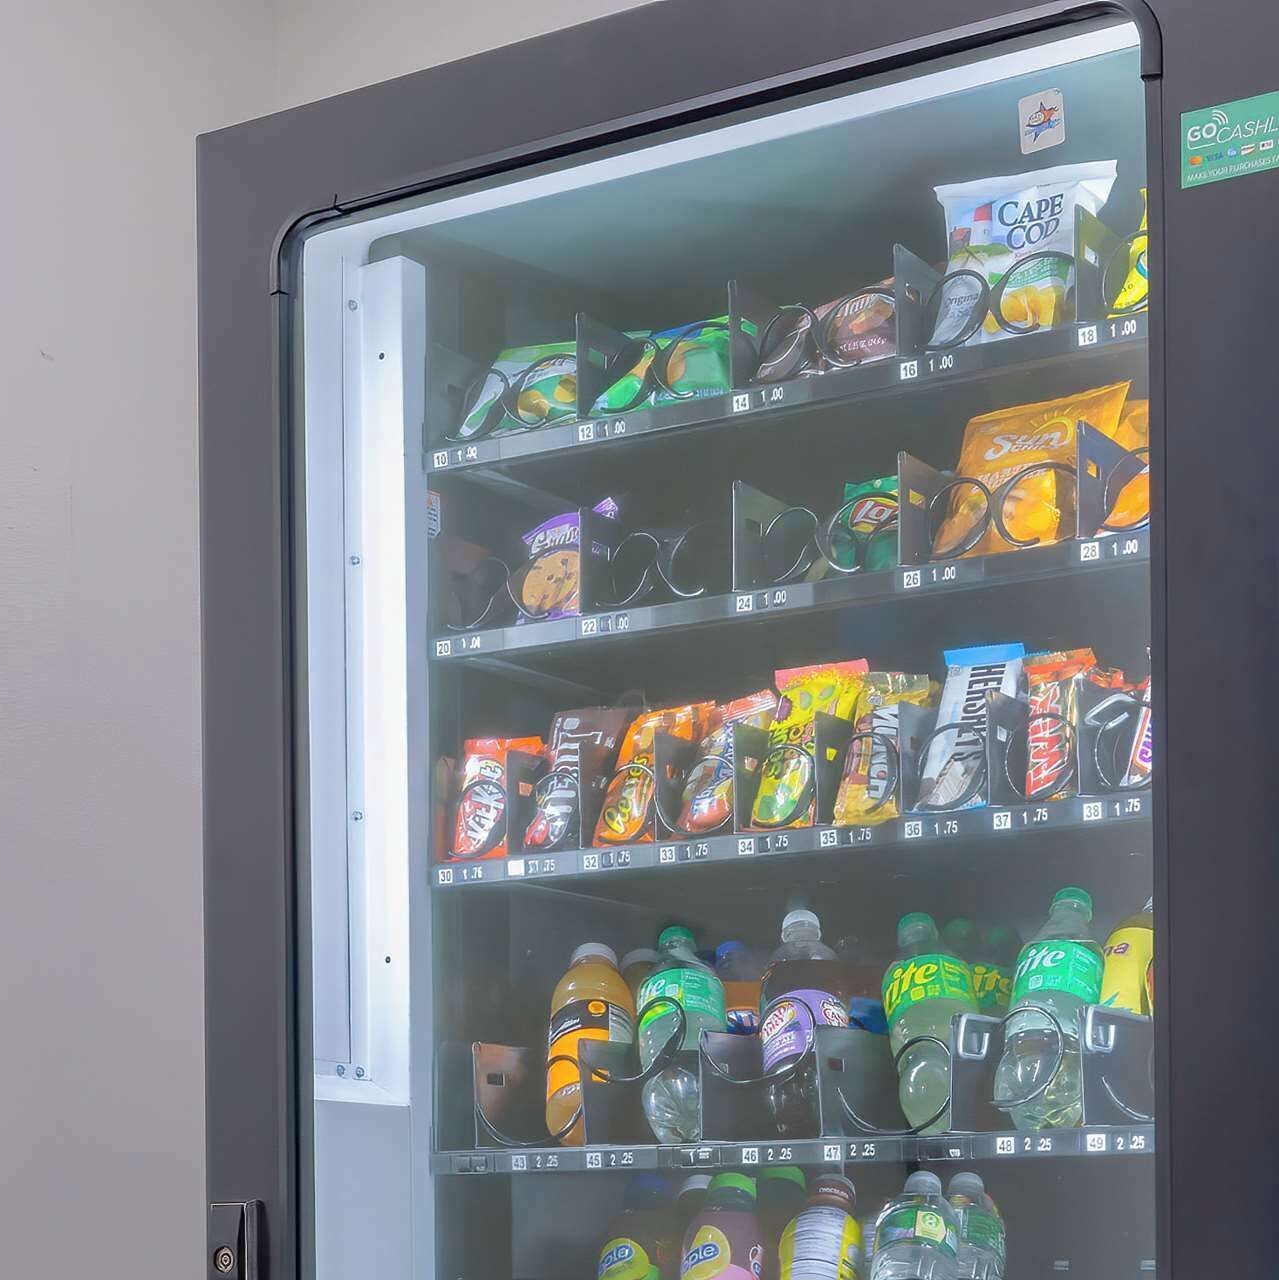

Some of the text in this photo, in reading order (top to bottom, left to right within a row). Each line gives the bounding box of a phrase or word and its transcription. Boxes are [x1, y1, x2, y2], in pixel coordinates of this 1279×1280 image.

[1187, 122, 1217, 142] GO
[998, 193, 1064, 226] CAPE
[1007, 218, 1060, 249] COD
